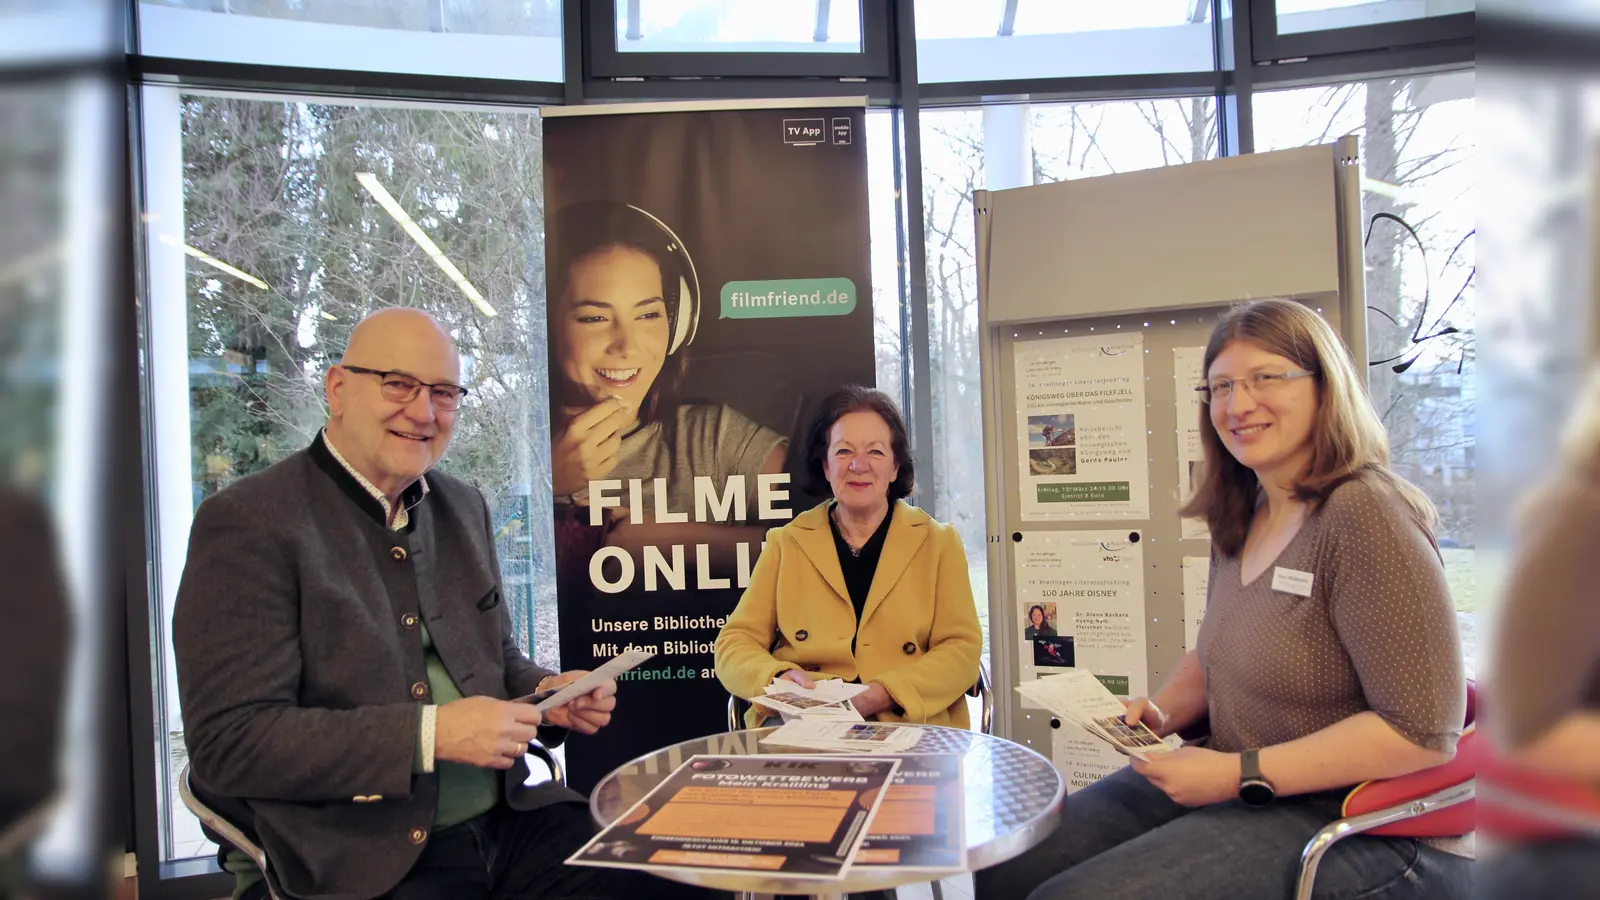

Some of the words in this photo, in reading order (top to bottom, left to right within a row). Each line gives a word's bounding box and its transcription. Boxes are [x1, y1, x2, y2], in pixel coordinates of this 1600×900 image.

[802, 127, 820, 136] App
[731, 289, 849, 307] filmfriend.de
[1026, 392, 1064, 401] KÖNIGSWEG
[588, 473, 793, 526] FILME
[588, 541, 768, 594] ONLI
[591, 618, 649, 632] Unsere
[593, 643, 618, 657] Mit
[664, 640, 715, 655] Bibliot
[764, 761, 818, 769] KIK
[692, 773, 868, 784] FOTOWETTBEWERB
